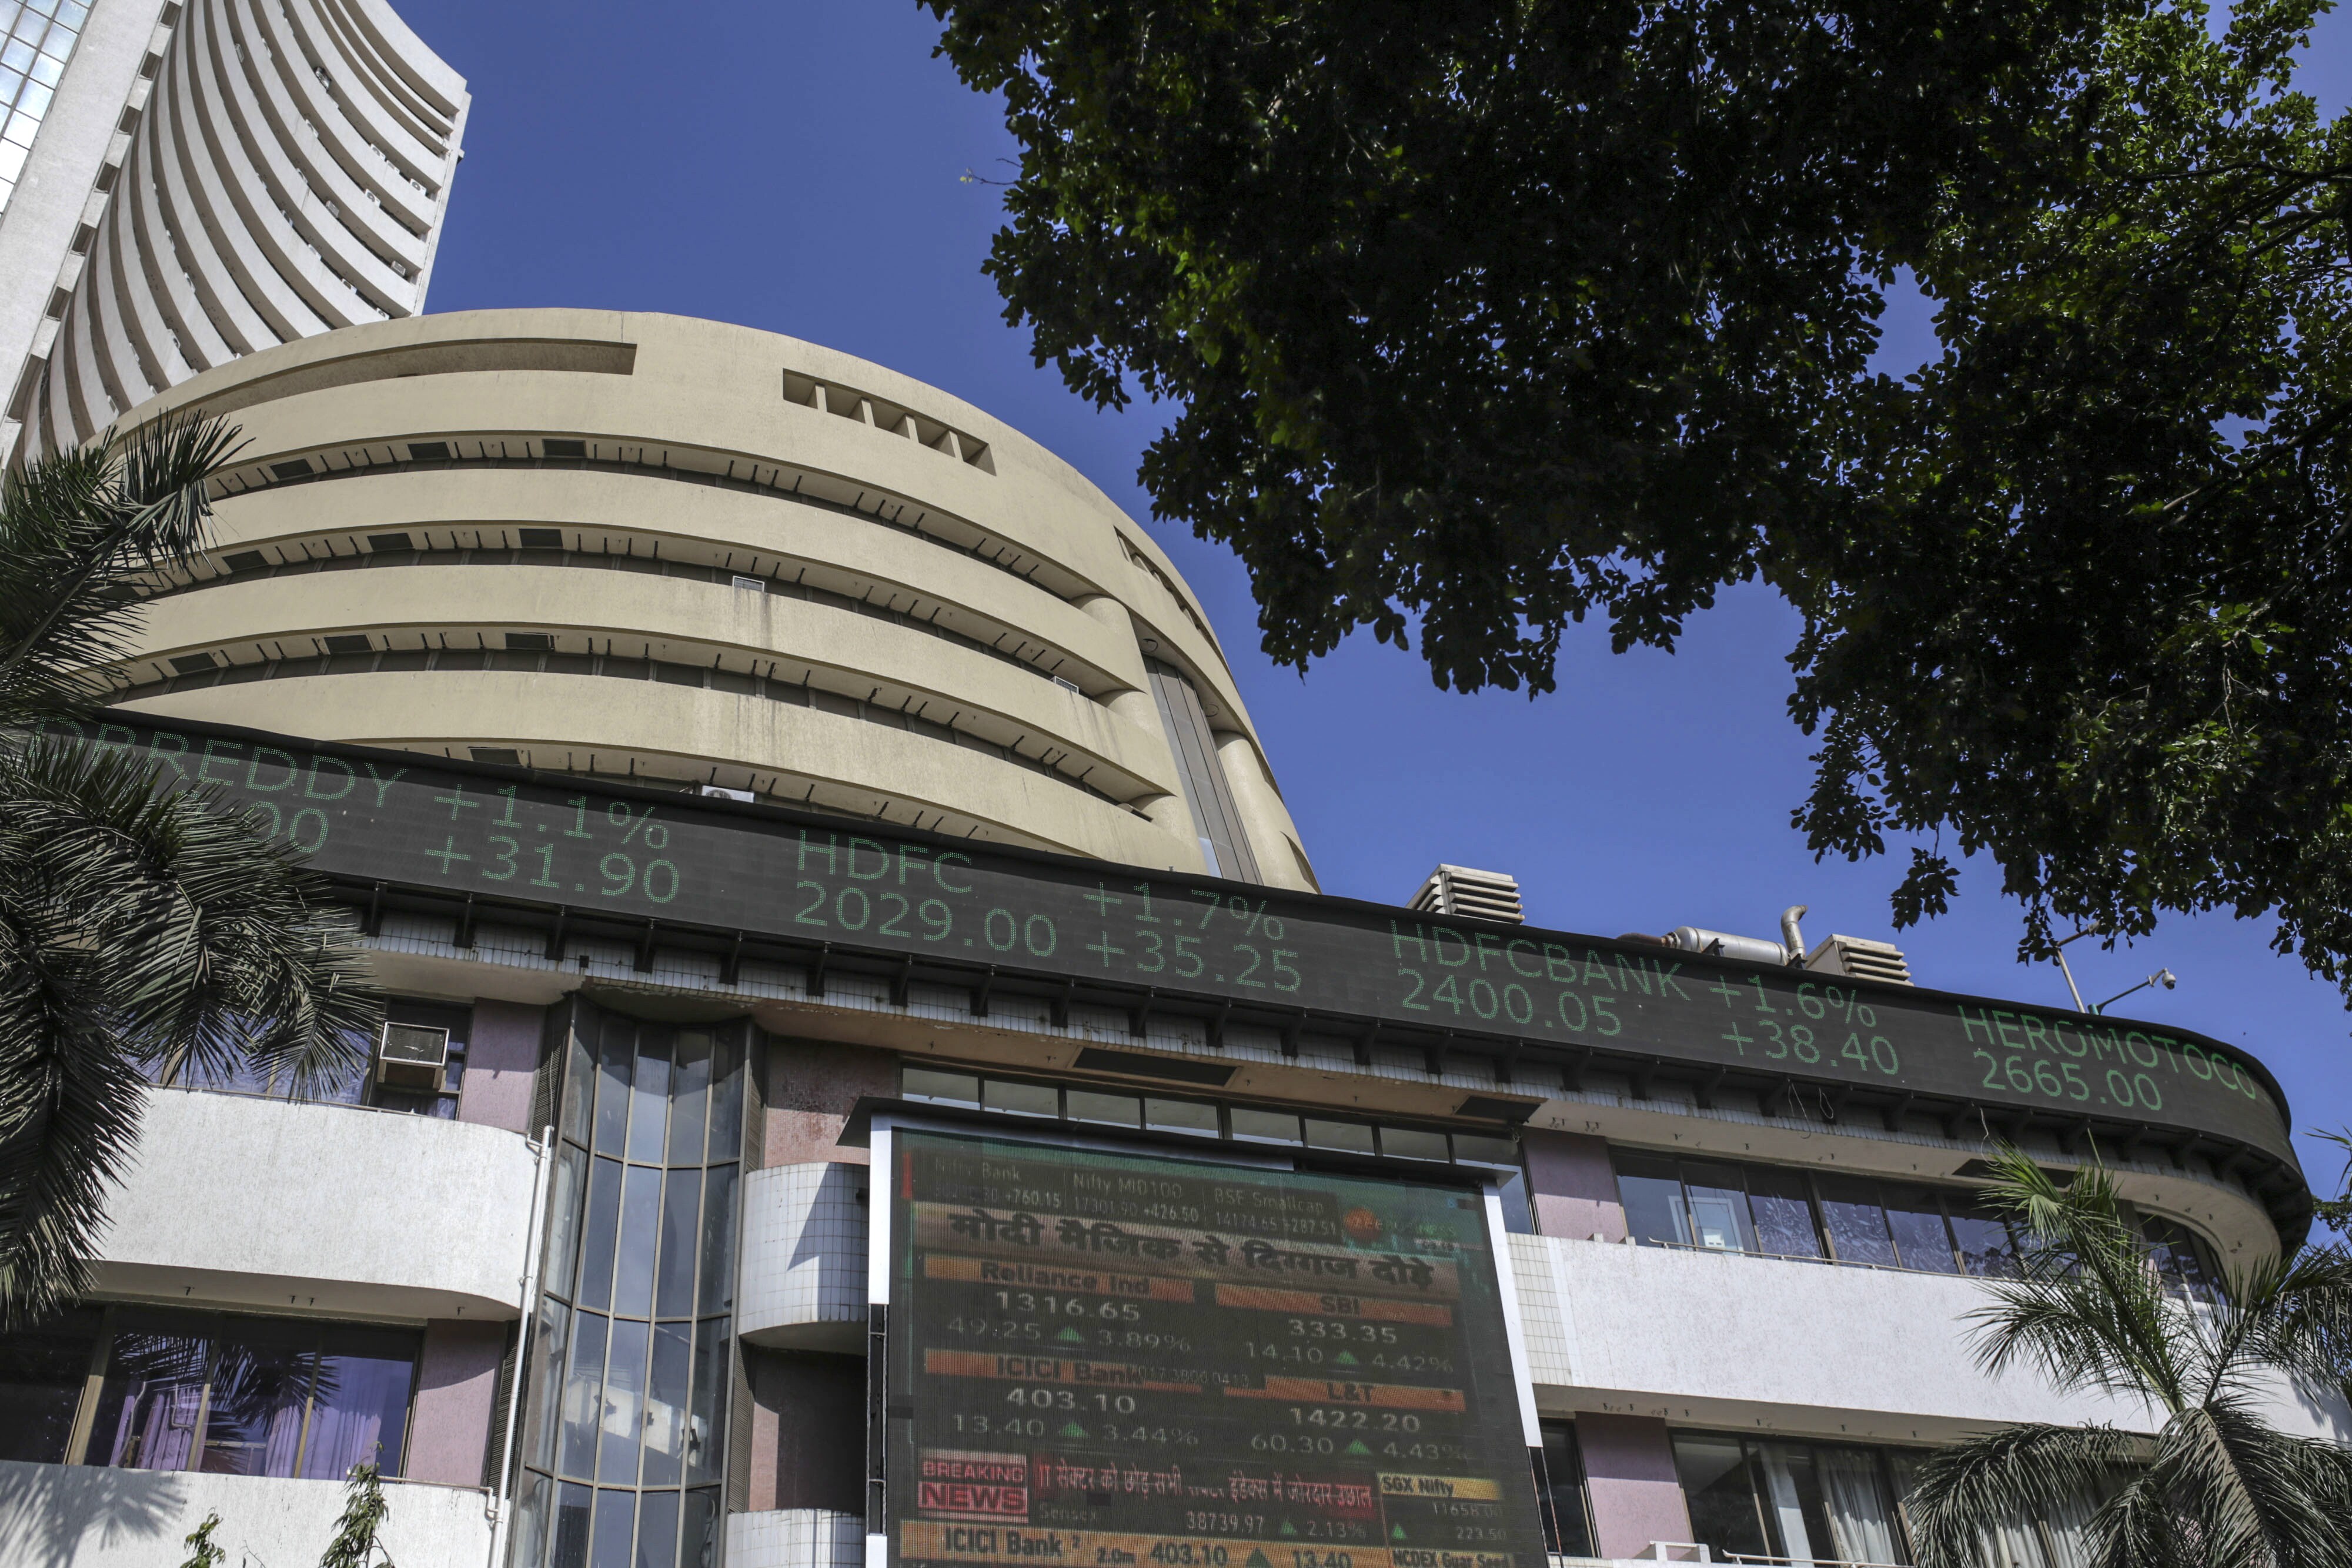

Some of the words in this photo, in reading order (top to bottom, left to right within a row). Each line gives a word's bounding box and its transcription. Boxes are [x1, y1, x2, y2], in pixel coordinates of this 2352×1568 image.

[434, 784, 669, 850] +1.1%
[798, 830, 972, 893] HDFC
[1083, 882, 1285, 940] +1.7%
[1391, 920, 1691, 1001] HDFCBANK
[1709, 975, 1876, 1028] +1.6%
[425, 835, 679, 903] +31.90
[795, 881, 1056, 957] 2029.00
[1086, 931, 1302, 992] +35.25
[1398, 968, 1622, 1037] 2400.05
[1721, 1020, 1899, 1075] +38.40
[1974, 1050, 2161, 1111] 2665.00
[982, 1161, 1022, 1181] Bank
[1073, 1172, 1111, 1196] Nifty
[1252, 1192, 1324, 1215] Smallcap
[948, 1208, 1044, 1246] मोदी
[1192, 1235, 1230, 1266] से
[982, 1261, 1098, 1290] Reliance
[1110, 1276, 1150, 1293] Ind
[997, 1291, 1140, 1321] 1316.65
[1321, 1296, 1361, 1315] SBI
[947, 1316, 1041, 1340] 49.25
[1098, 1329, 1191, 1352] 3.89%
[1289, 1318, 1398, 1344] 333.35
[997, 1356, 1060, 1379] ICICI
[1246, 1342, 1323, 1364] 14.10
[1372, 1353, 1454, 1374] 4.42%
[1007, 1387, 1136, 1414] 403.10
[1327, 1382, 1375, 1402] L&T
[953, 1414, 1044, 1436] 13.40
[1102, 1424, 1198, 1445] 3.44%
[1289, 1407, 1421, 1433] 1422.20
[1251, 1433, 1334, 1455] 60.30
[923, 1461, 1025, 1482] BREAKING
[921, 1483, 1026, 1512] NEWS
[1383, 1476, 1414, 1492] SGX
[1418, 1478, 1454, 1497] Nifty
[1185, 1510, 1264, 1533] 38739.97
[946, 1529, 997, 1553] ICICI
[1006, 1532, 1063, 1557] Bank
[1150, 1543, 1229, 1566] 403.10
[1293, 1550, 1351, 1568] 13.40
